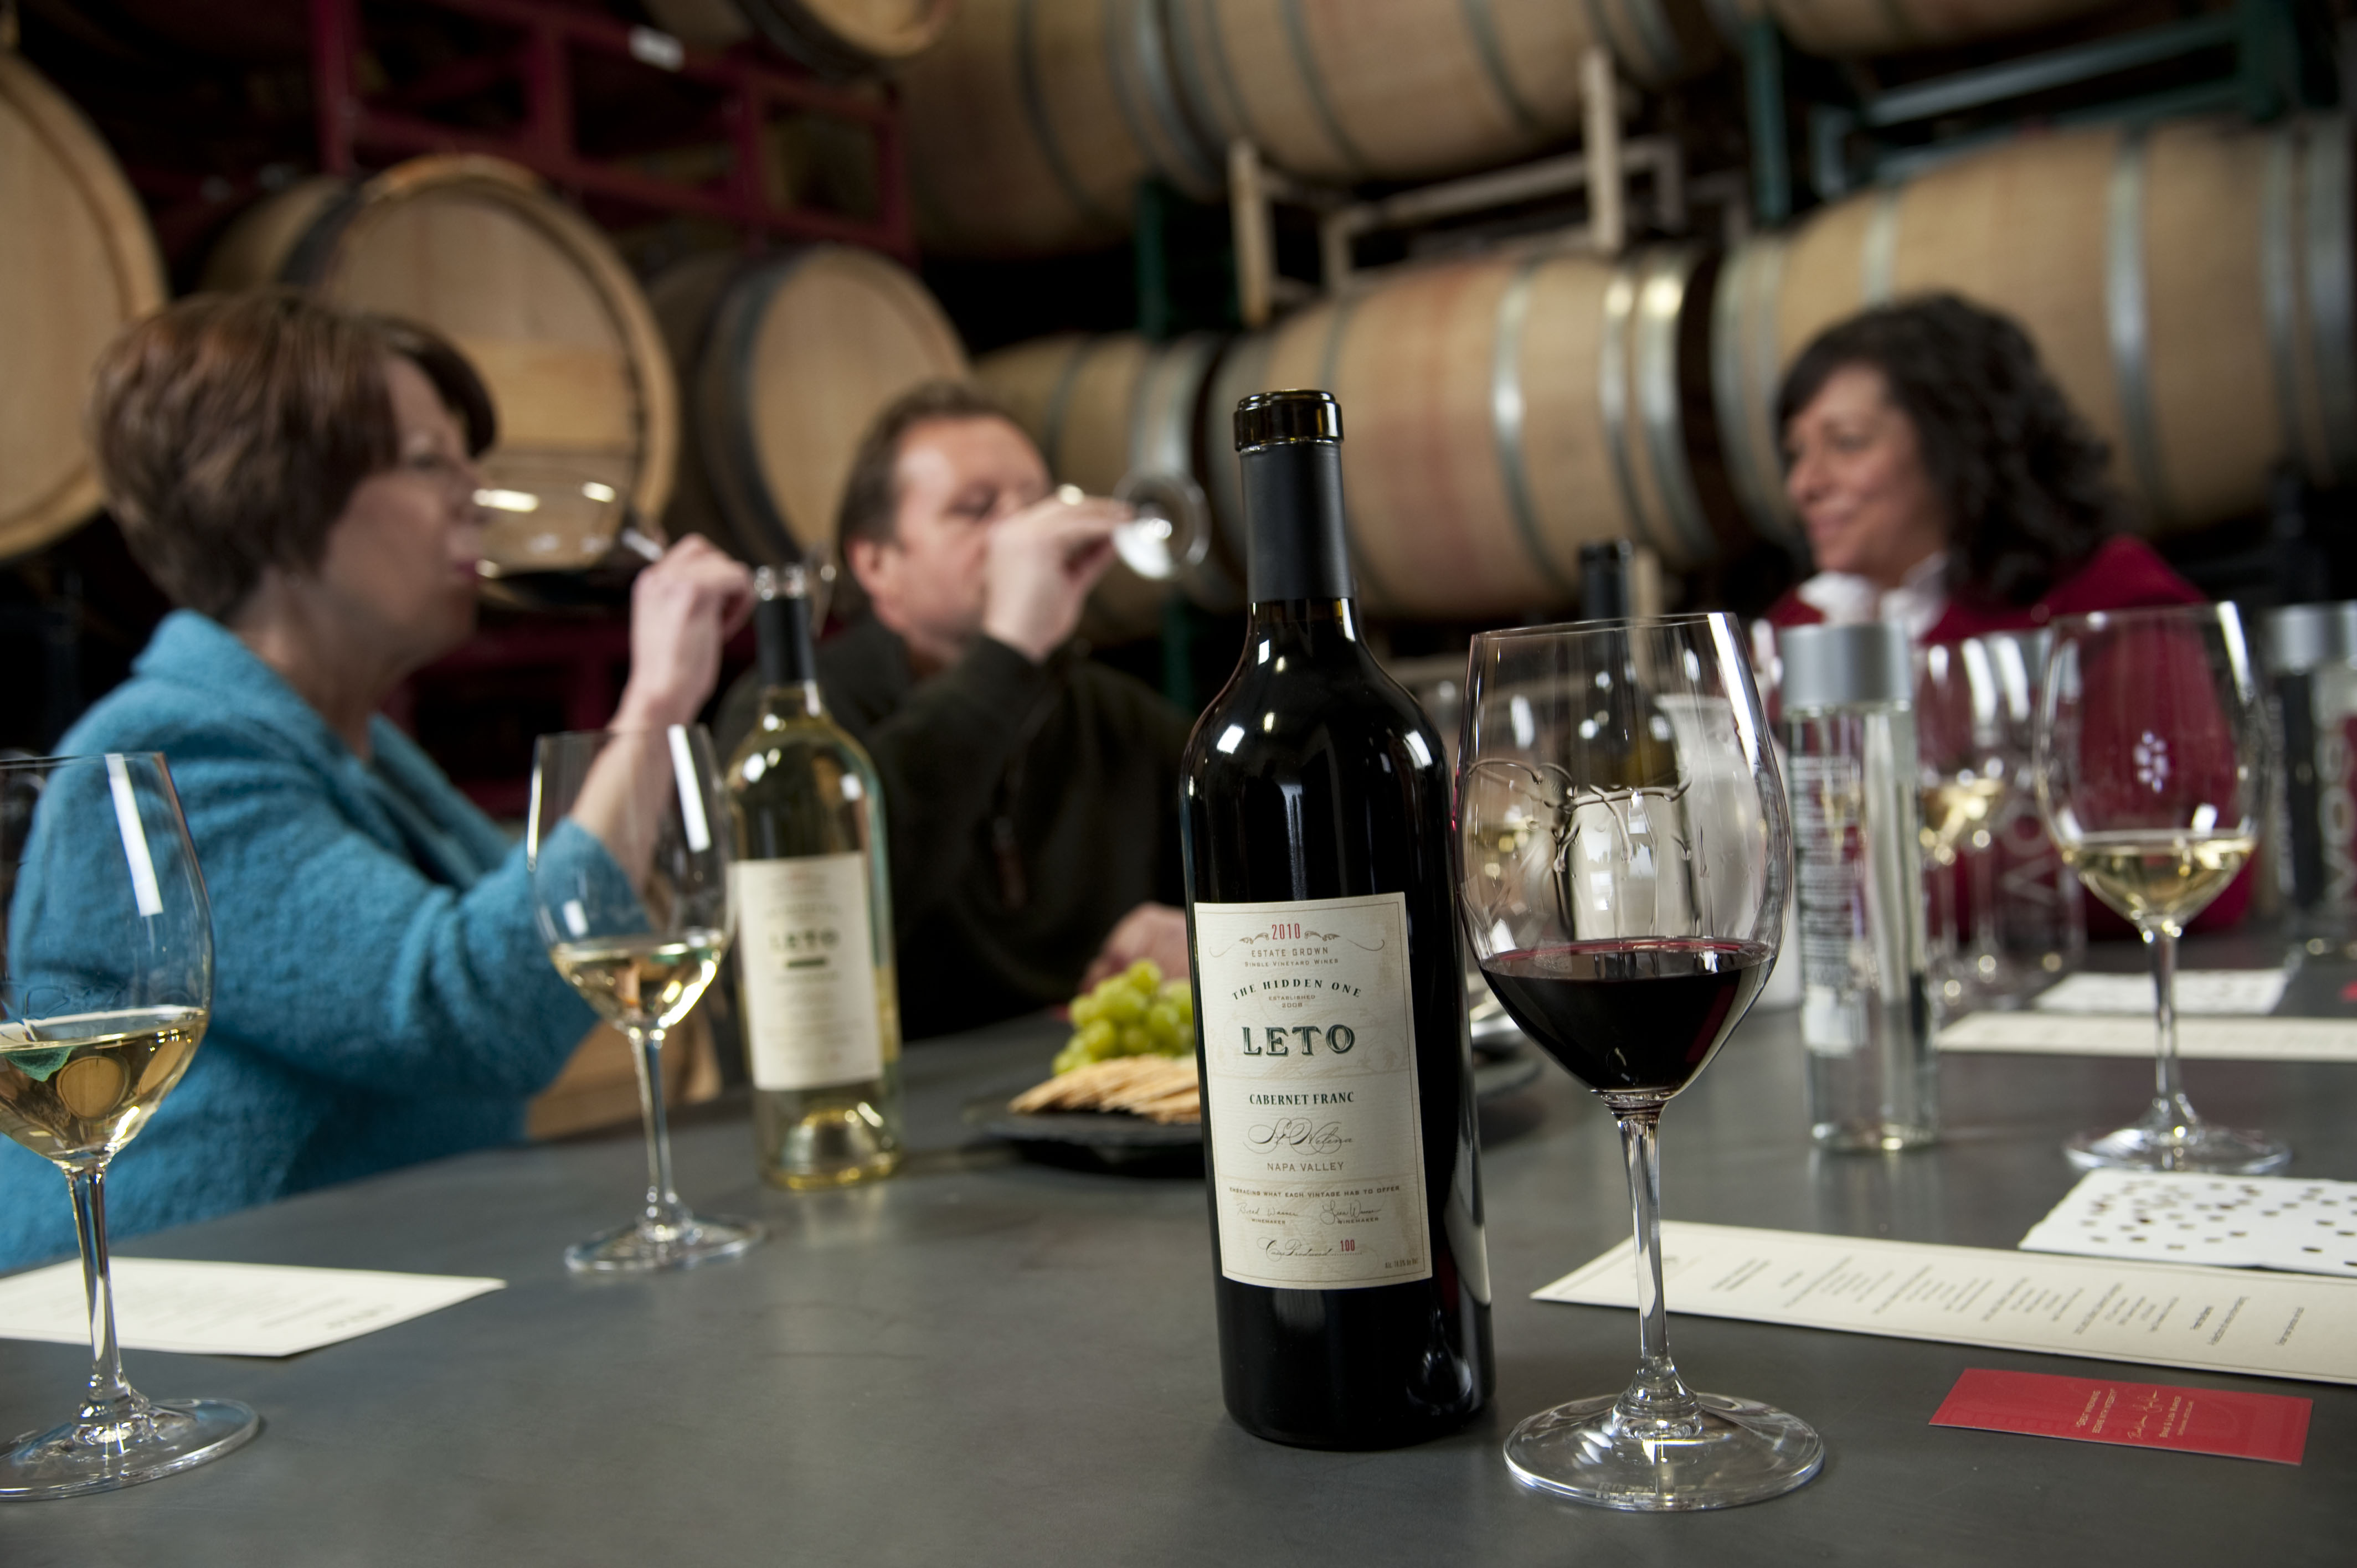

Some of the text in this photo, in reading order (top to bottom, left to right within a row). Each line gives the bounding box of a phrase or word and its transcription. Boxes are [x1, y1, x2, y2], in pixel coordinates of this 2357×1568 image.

[1272, 924, 1300, 940] 2010
[1293, 947, 1328, 956] GROWN
[1232, 978, 1361, 1000] THE HIDDEN ONE
[1241, 1024, 1355, 1056] LETO
[1249, 1091, 1354, 1105] CABERNET FRANC
[1289, 1117, 1354, 1156] Helena
[1267, 1162, 1344, 1172] NAPA VALLEY
[1229, 1187, 1260, 1196] EMBRACING
[1340, 1240, 1355, 1252] 100
